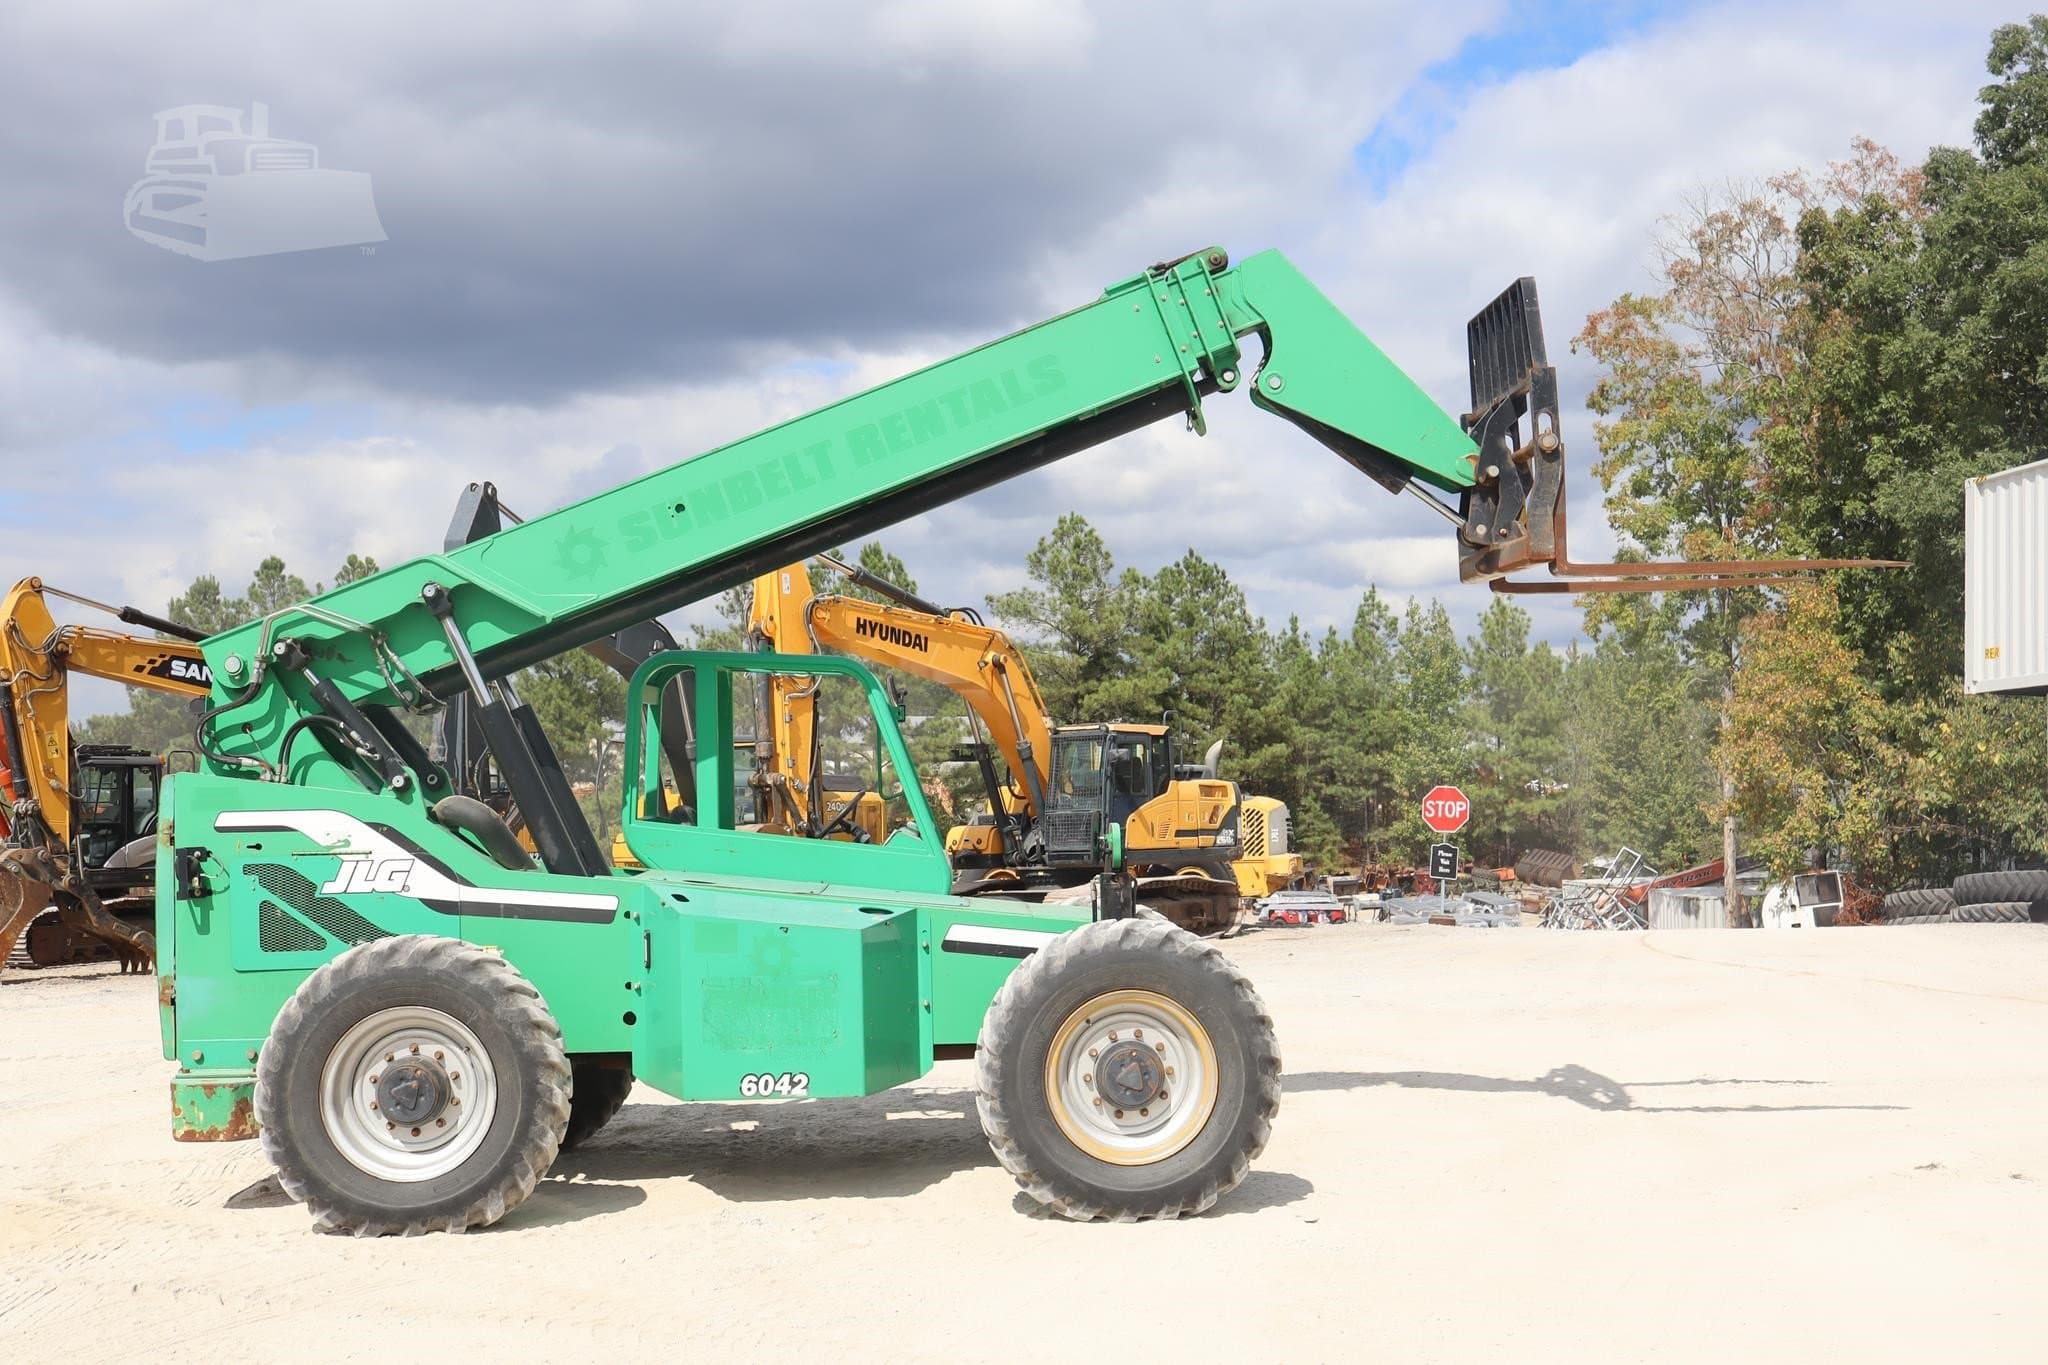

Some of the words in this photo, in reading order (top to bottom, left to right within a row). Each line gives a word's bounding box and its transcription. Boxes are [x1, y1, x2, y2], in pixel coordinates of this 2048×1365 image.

[617, 439, 835, 553] SUNBELT
[845, 354, 1068, 469] RENTALS
[856, 616, 928, 653] HYUNDAI
[1425, 800, 1467, 818] STOP
[740, 1072, 810, 1097] 6042
